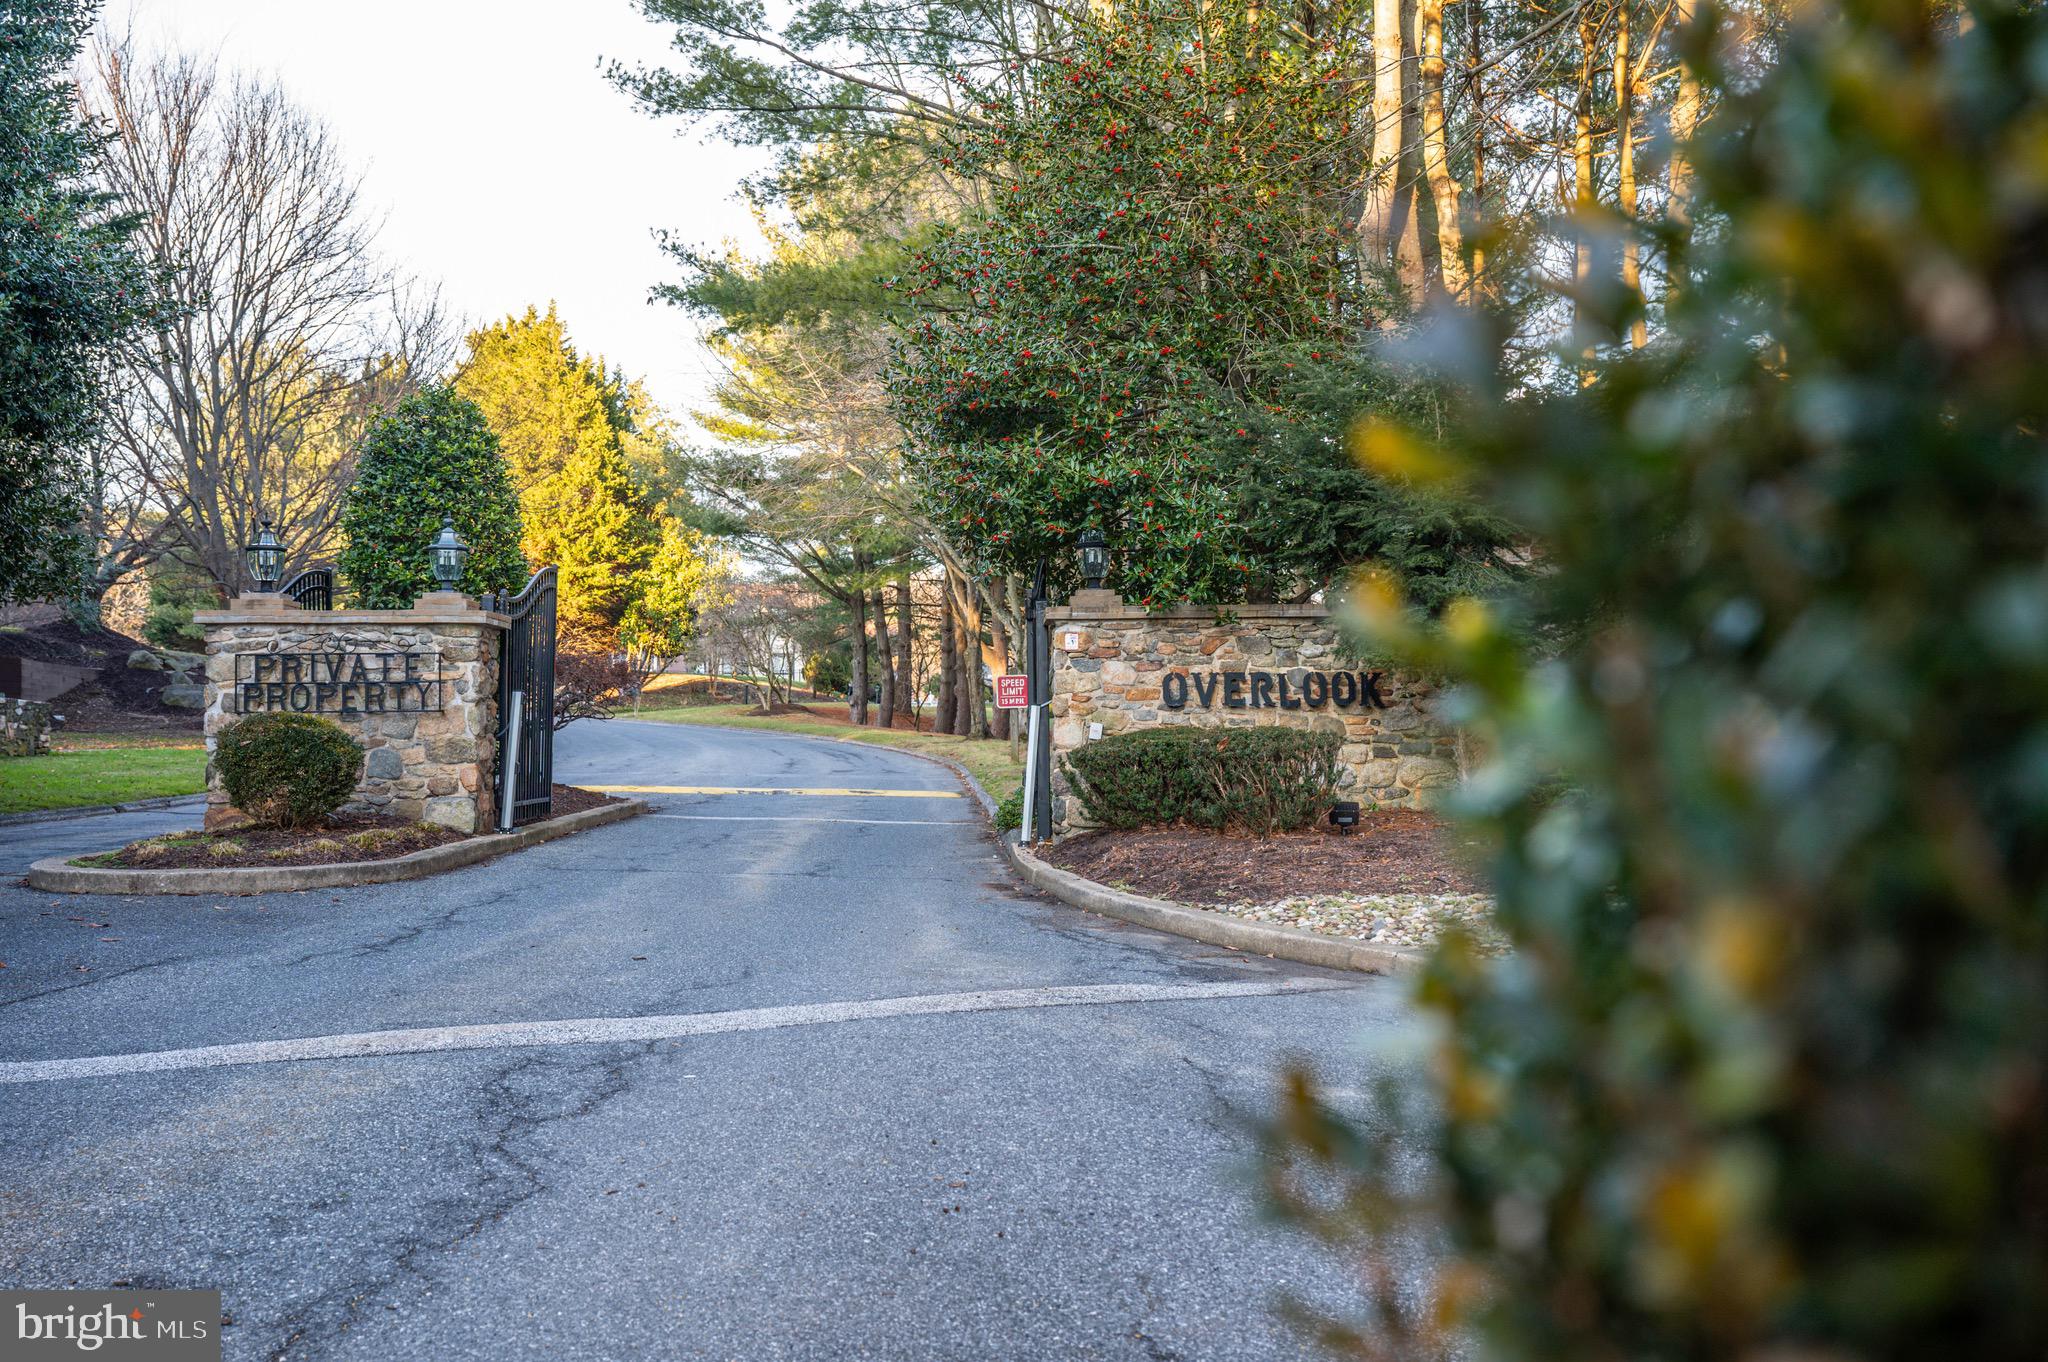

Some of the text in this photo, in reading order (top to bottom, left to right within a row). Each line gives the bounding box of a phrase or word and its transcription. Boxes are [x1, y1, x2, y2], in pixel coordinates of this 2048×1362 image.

[253, 653, 421, 683] PRIVATE
[1001, 678, 1024, 687] SPEED
[243, 682, 434, 712] PROPERTY
[1002, 687, 1023, 696] LIMIT
[1162, 671, 1386, 709] OVERLOOK
